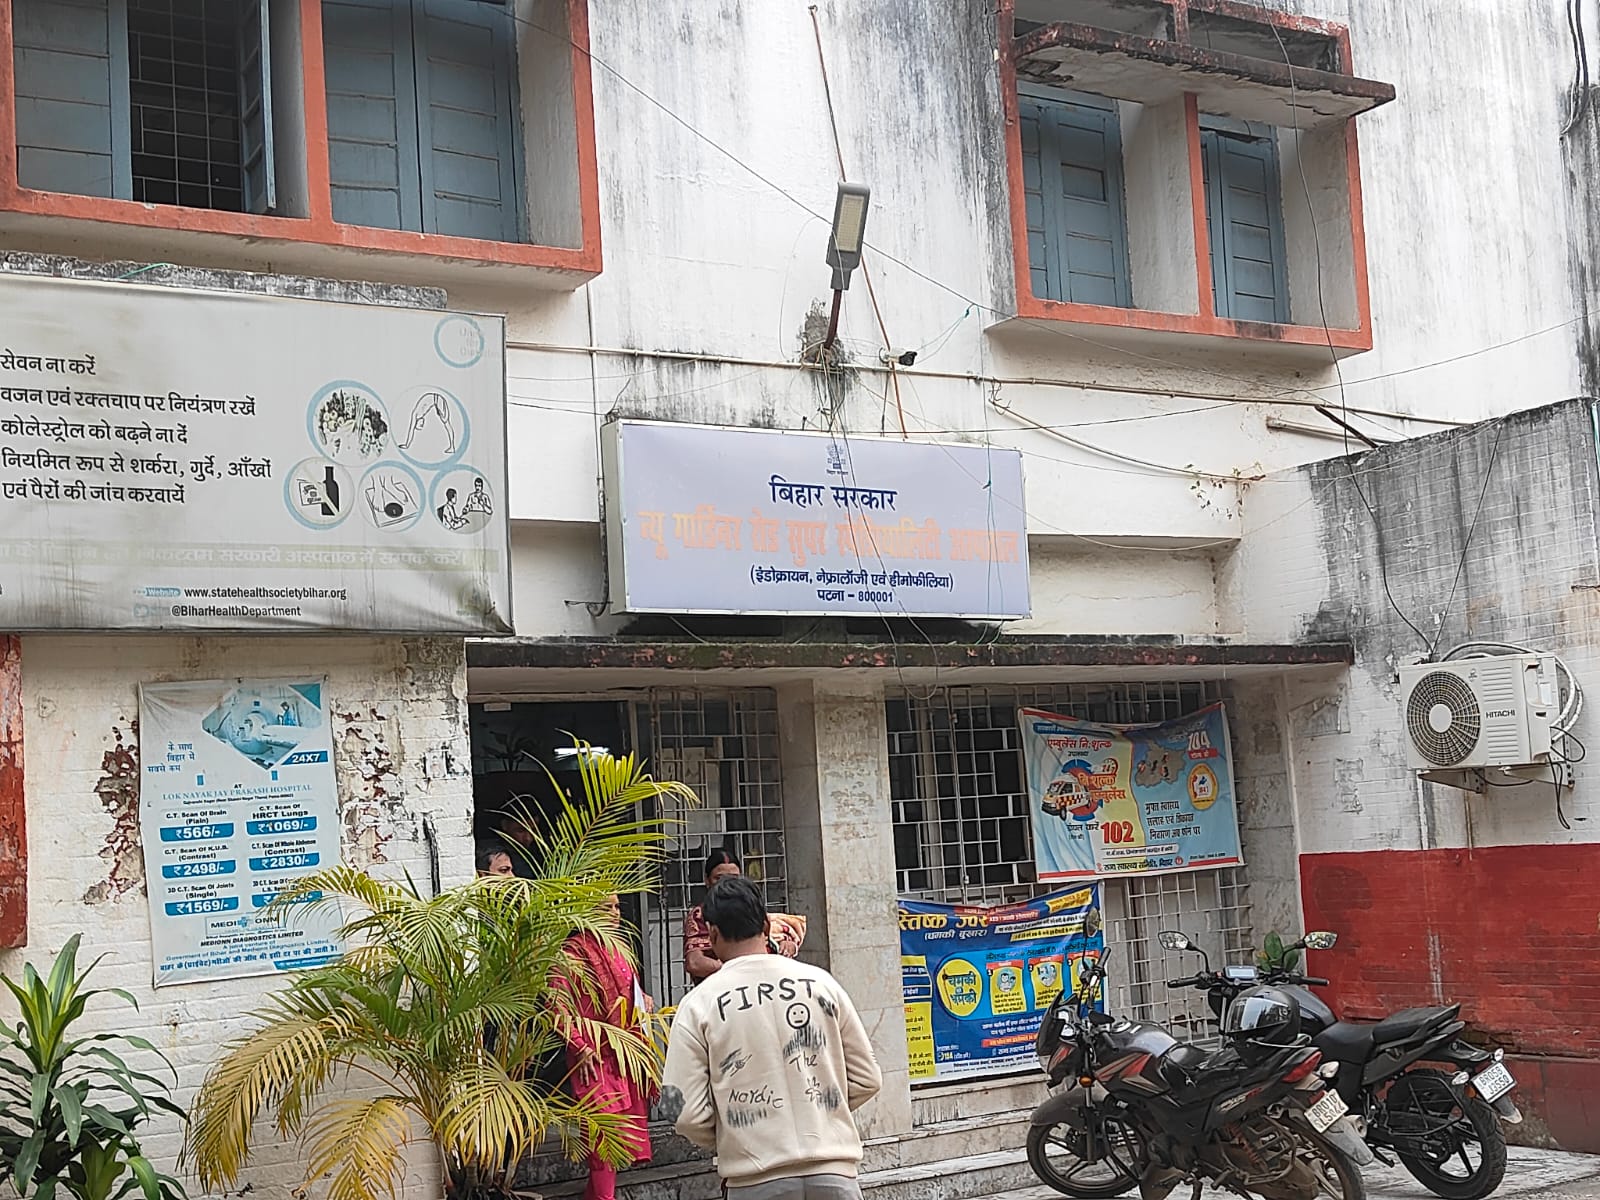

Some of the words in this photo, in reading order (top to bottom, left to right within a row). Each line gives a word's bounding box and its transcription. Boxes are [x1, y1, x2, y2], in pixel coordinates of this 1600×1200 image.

[0, 349, 42, 372] सेवन
[45, 357, 65, 373] ना
[68, 354, 96, 375] करें
[0, 387, 43, 404] वजन
[46, 386, 71, 406] एवं
[74, 391, 141, 410] रक्तचाप
[144, 395, 166, 411] पर
[168, 392, 226, 414] नियंत्रण
[229, 395, 255, 415] रखें
[1, 414, 85, 442] कोलेस्ट्रोल
[88, 419, 111, 440] को
[114, 421, 152, 444] बढ़ने
[155, 428, 174, 443] ना
[177, 423, 188, 443] दें
[2, 447, 70, 469] नियमित
[75, 456, 104, 471] रूप
[109, 452, 125, 472] से
[130, 453, 184, 477] शर्करा,
[190, 455, 221, 481] गुर्दे,
[228, 456, 271, 478] आँखों
[2, 479, 27, 498] एवं
[29, 478, 59, 499] पैरों
[64, 480, 86, 500] की
[90, 482, 125, 502] जांच
[128, 483, 184, 503] करवायें
[768, 474, 825, 508] बिहार
[830, 485, 897, 511] सरकार
[871, 569, 886, 585] एवं
[184, 587, 347, 600] www.statehealthsocietybihar.org
[817, 589, 845, 602] पटना
[858, 591, 893, 603] 800001
[171, 605, 301, 618] @BiharHealthDepartment
[1485, 709, 1516, 719] HITACHI
[1188, 731, 1211, 751] 104
[183, 791, 212, 799] NAYAK
[214, 789, 228, 797] JAY
[230, 787, 268, 796] PRAKASH
[270, 784, 312, 793] HOSPITAL
[253, 811, 278, 819] HRCT
[281, 809, 309, 817] Lungs
[1100, 821, 1135, 844] 102
[200, 939, 231, 947] MEDIONN
[233, 934, 276, 943] DIAGNOSTICS
[716, 977, 816, 1022] FIRST
[789, 1050, 818, 1072] The
[728, 1085, 783, 1109] Nordic
